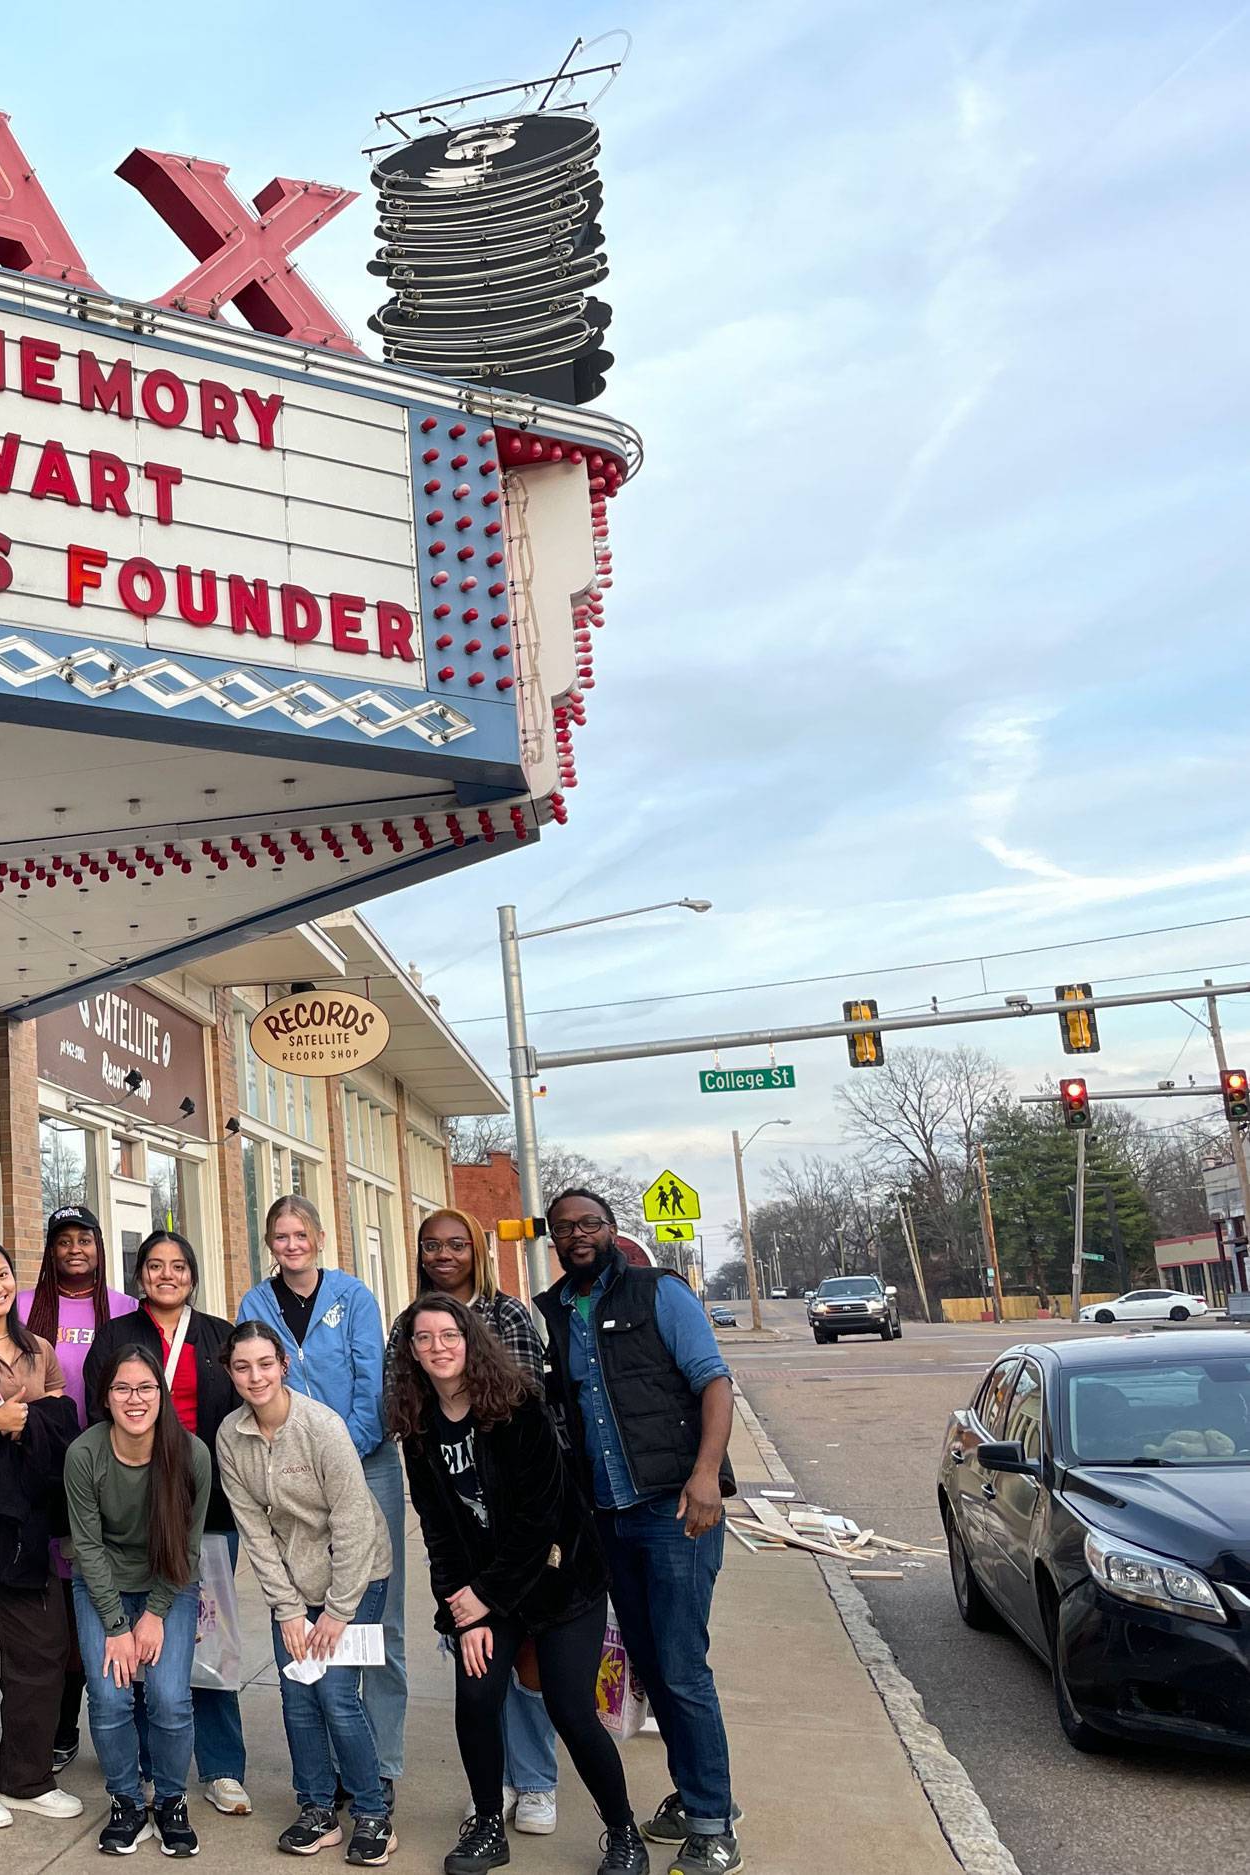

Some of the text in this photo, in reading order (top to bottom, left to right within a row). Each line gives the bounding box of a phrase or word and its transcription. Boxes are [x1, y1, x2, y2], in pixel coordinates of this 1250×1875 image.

[67, 544, 416, 662] FOUNDER
[94, 991, 159, 1065] SATELLITE
[263, 1001, 374, 1040] RECORDS
[289, 1032, 350, 1047] SATELLITE
[282, 1049, 359, 1061] RECORD SHOP
[705, 1069, 789, 1090] College St
